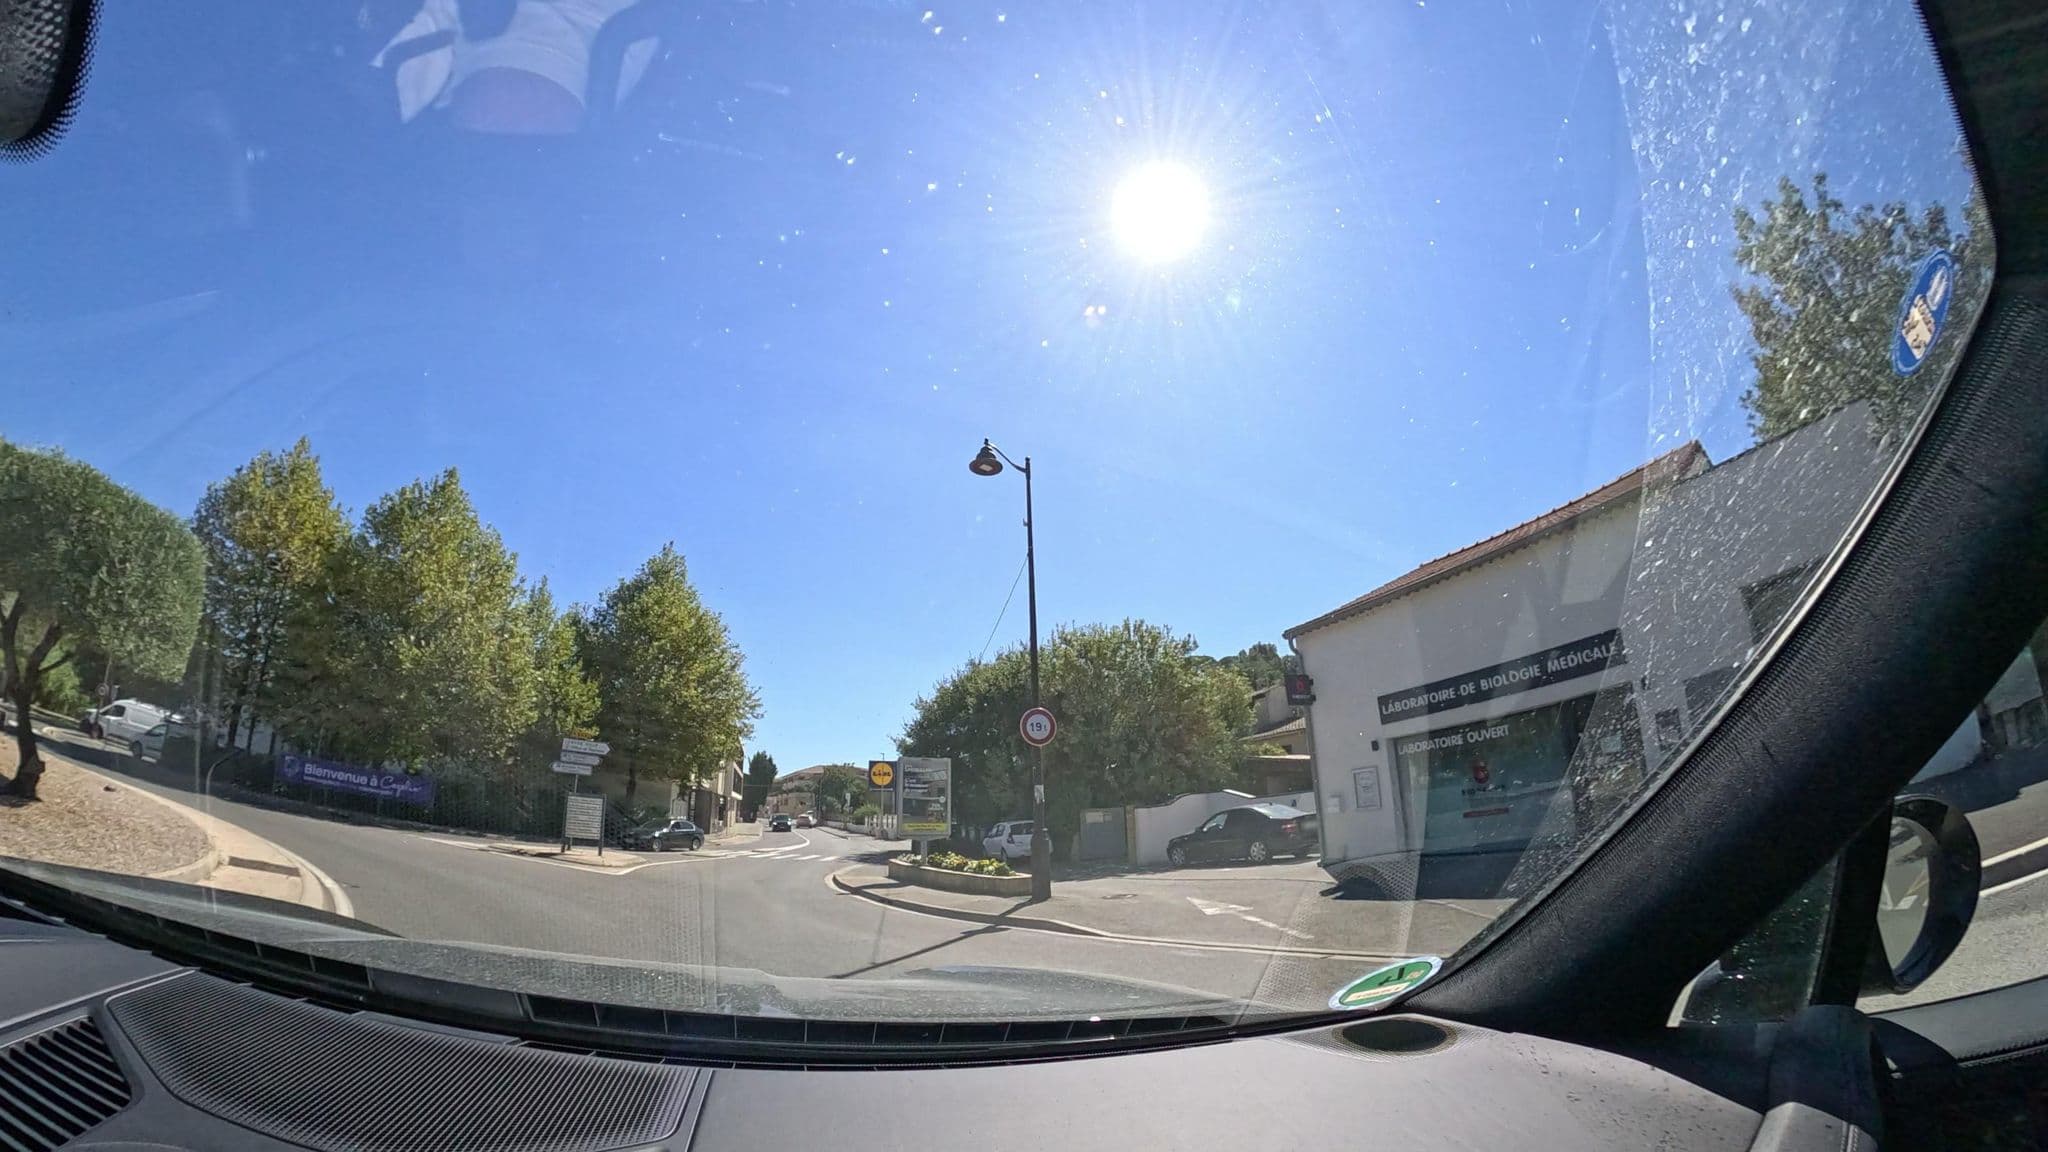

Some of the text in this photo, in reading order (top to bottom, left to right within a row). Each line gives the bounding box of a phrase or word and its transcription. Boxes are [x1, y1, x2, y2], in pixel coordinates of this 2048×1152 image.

[1381, 687, 1457, 715] LABORATOIRE
[1460, 682, 1477, 697] DE
[1480, 664, 1542, 692] BIOLOGIE
[1030, 722, 1042, 732] 19
[1399, 725, 1510, 755] LABORATOIRE OUVERT
[303, 763, 368, 785] Bienvenue
[370, 775, 378, 787] à
